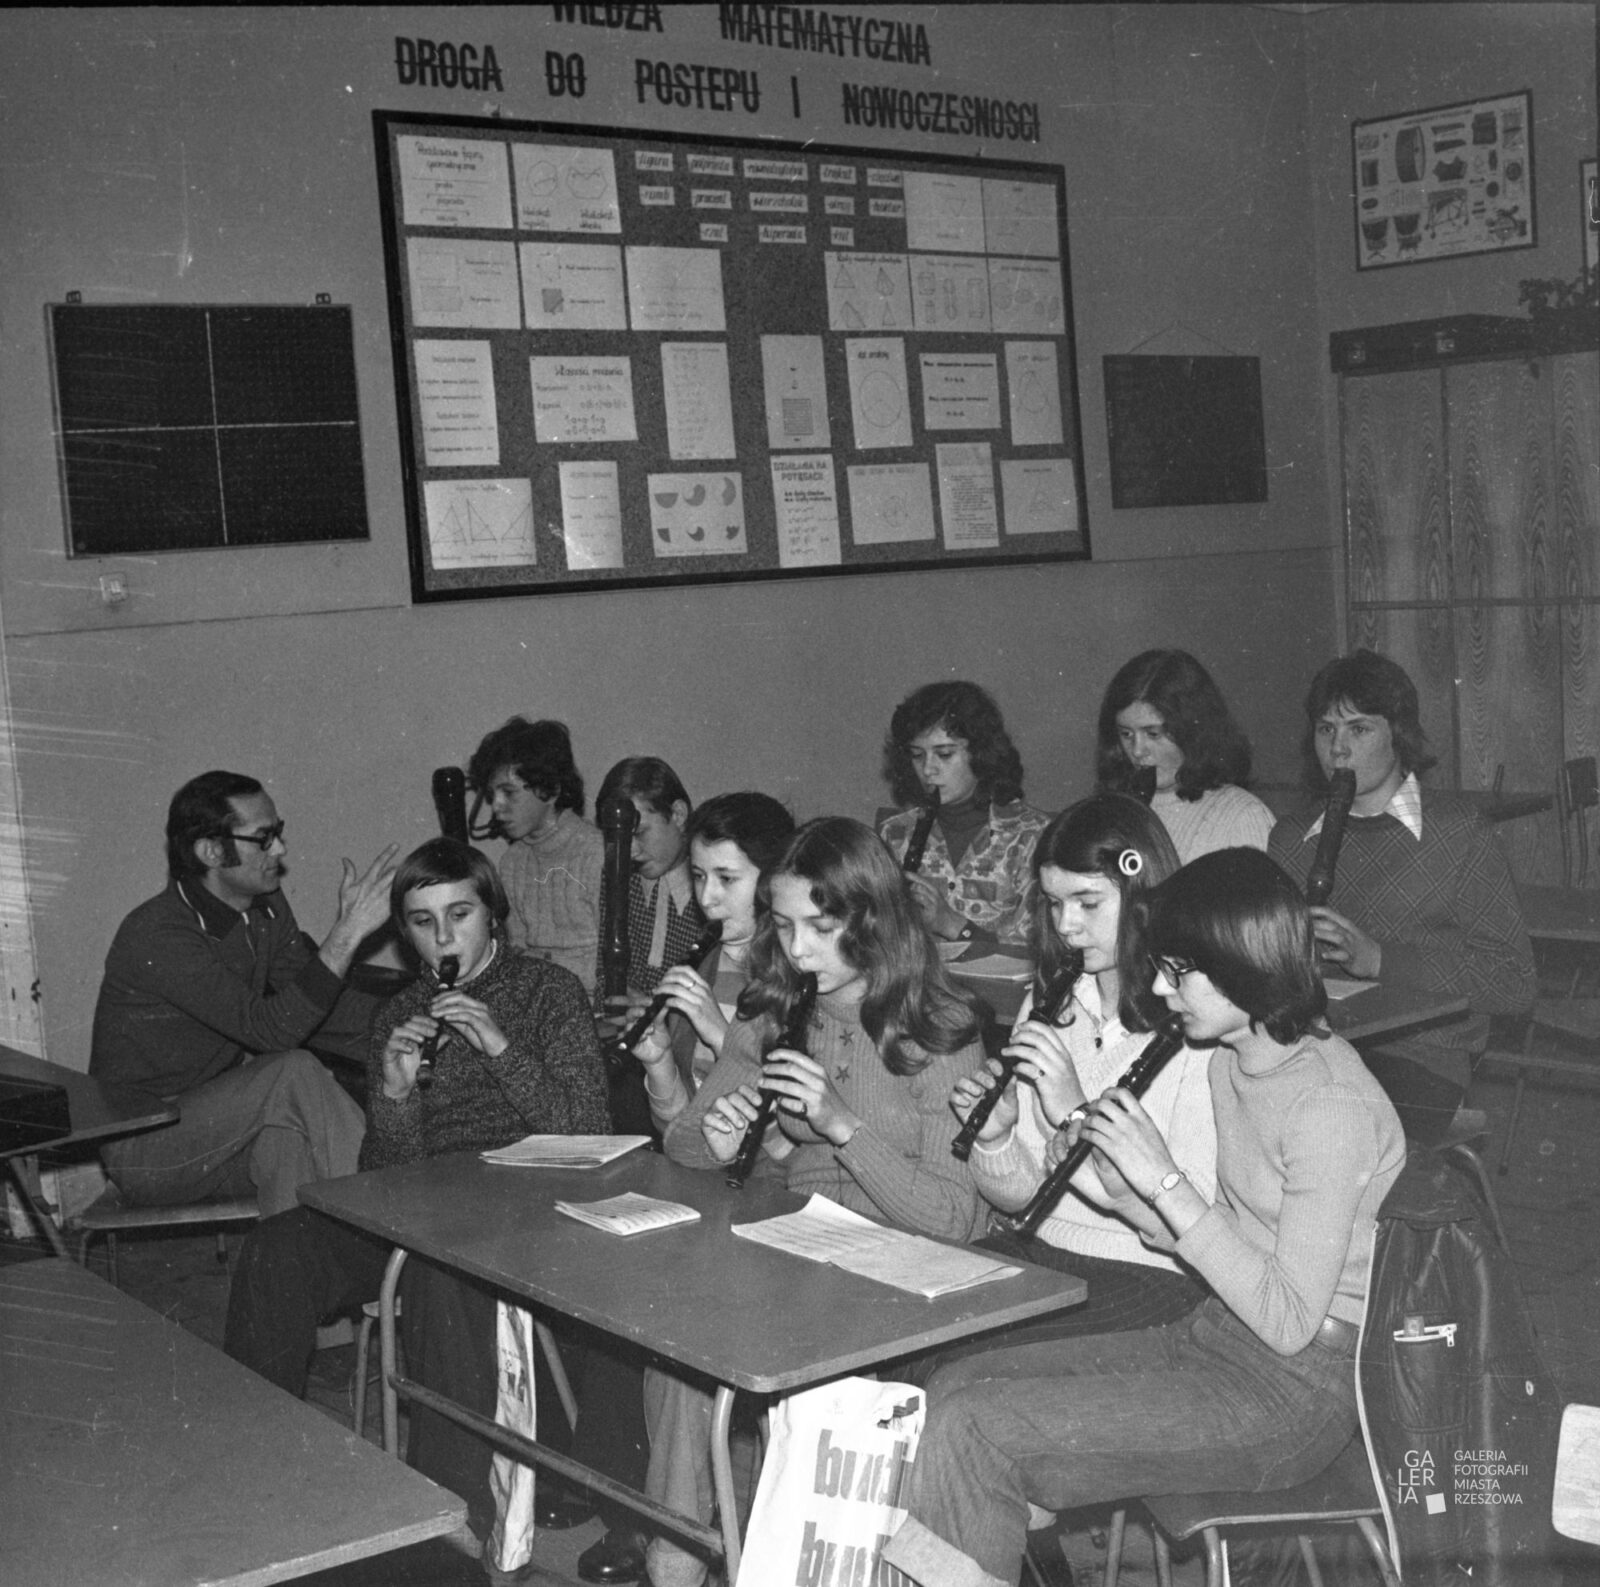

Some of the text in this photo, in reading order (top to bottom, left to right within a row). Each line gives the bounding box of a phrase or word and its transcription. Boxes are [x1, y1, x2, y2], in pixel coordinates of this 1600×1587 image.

[719, 4, 931, 66] MATEMATYCZNA
[395, 36, 1040, 142] DROGA DO POSTEPU I NOWOCZESNOSCI
